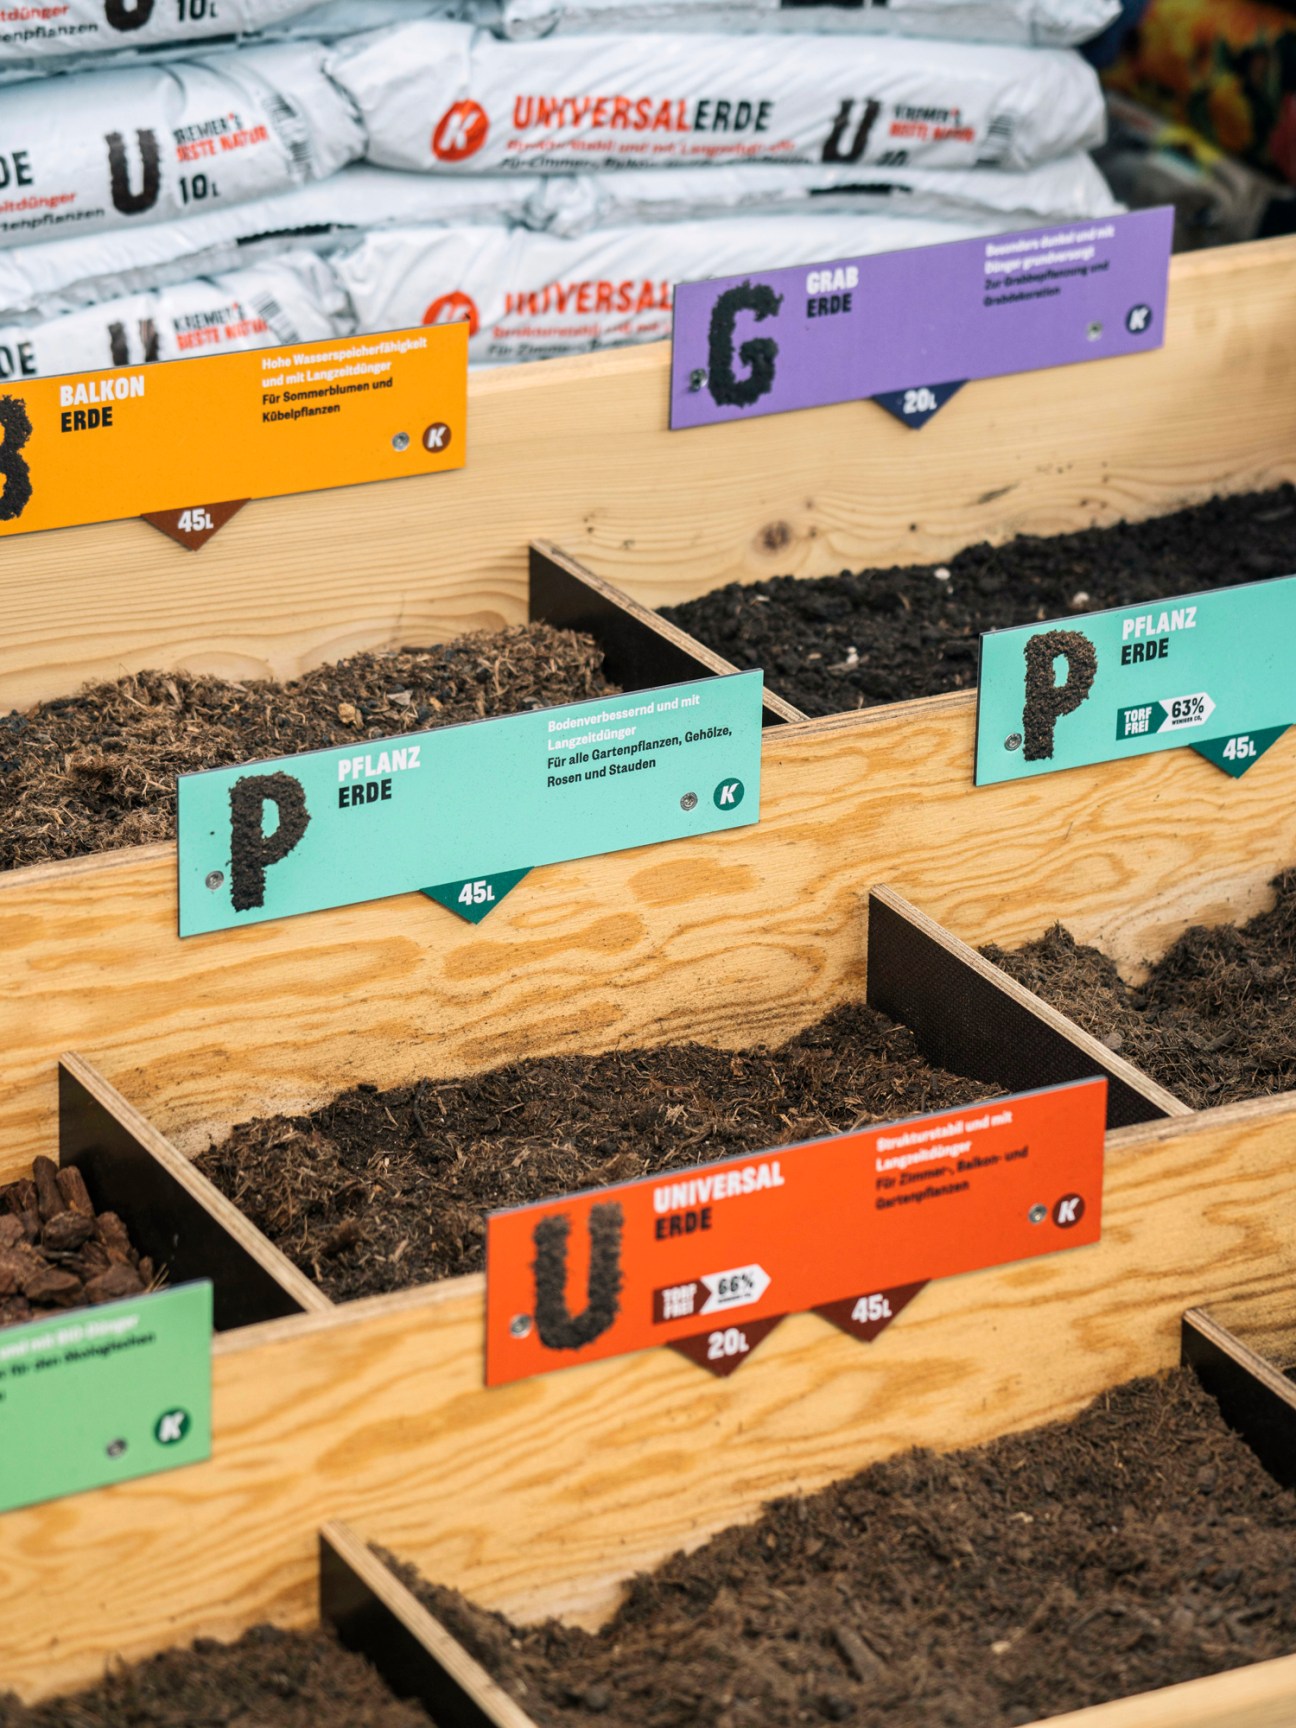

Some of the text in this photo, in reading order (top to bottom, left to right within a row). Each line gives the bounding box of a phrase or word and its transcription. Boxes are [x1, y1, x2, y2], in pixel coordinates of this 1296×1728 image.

[822, 98, 881, 164] U
[104, 127, 162, 216] U
[180, 174, 220, 205] 10L
[806, 266, 859, 295] GRAB
[807, 293, 852, 318] ERDE
[1129, 306, 1149, 331] K
[262, 337, 428, 370] Hohe Wasserspeicherfähigkeit
[708, 280, 784, 409] G
[262, 361, 392, 388] und mit Langzeitdünger
[60, 375, 145, 407] BALKON
[262, 377, 393, 405] Für Sommerblumen und
[903, 387, 937, 414] 20L
[61, 406, 113, 433] ERDE
[262, 403, 341, 423] Kübelpflanzen
[427, 426, 447, 449] K
[177, 508, 214, 532] 45L
[1122, 606, 1198, 640] PFLANZ
[1121, 637, 1170, 666] ERDE
[1022, 629, 1098, 762] P
[1171, 696, 1205, 719] 63%
[548, 694, 701, 733] Bodenverbessernd und mit
[1124, 706, 1153, 724] TORF
[1124, 719, 1149, 736] FREI
[547, 726, 637, 751] Langzeitdünger
[547, 726, 732, 769] Für alle Gartenpflanzen, Gehölze,
[1222, 736, 1257, 761] 45L
[338, 746, 421, 781] PFLANZ
[547, 758, 656, 788] Rosen und Stauden
[338, 778, 392, 809] ERDE
[719, 782, 740, 805] K
[226, 770, 312, 912] P
[458, 880, 495, 906] 45L
[876, 1110, 1013, 1152] Strukturstabil und mit
[875, 1140, 972, 1172] Langzeitdünger
[876, 1177, 896, 1190] Für
[1005, 1146, 1029, 1162] und
[653, 1161, 785, 1214] UNIVERSAL
[876, 1180, 970, 1210] Gartenpflanzen
[655, 1207, 712, 1241] ERDE
[1058, 1198, 1081, 1224] K
[530, 1200, 625, 1351] U
[718, 1273, 754, 1295] 66%
[852, 1293, 892, 1323] 45L
[707, 1327, 750, 1360] 20L
[158, 1411, 185, 1443] K
